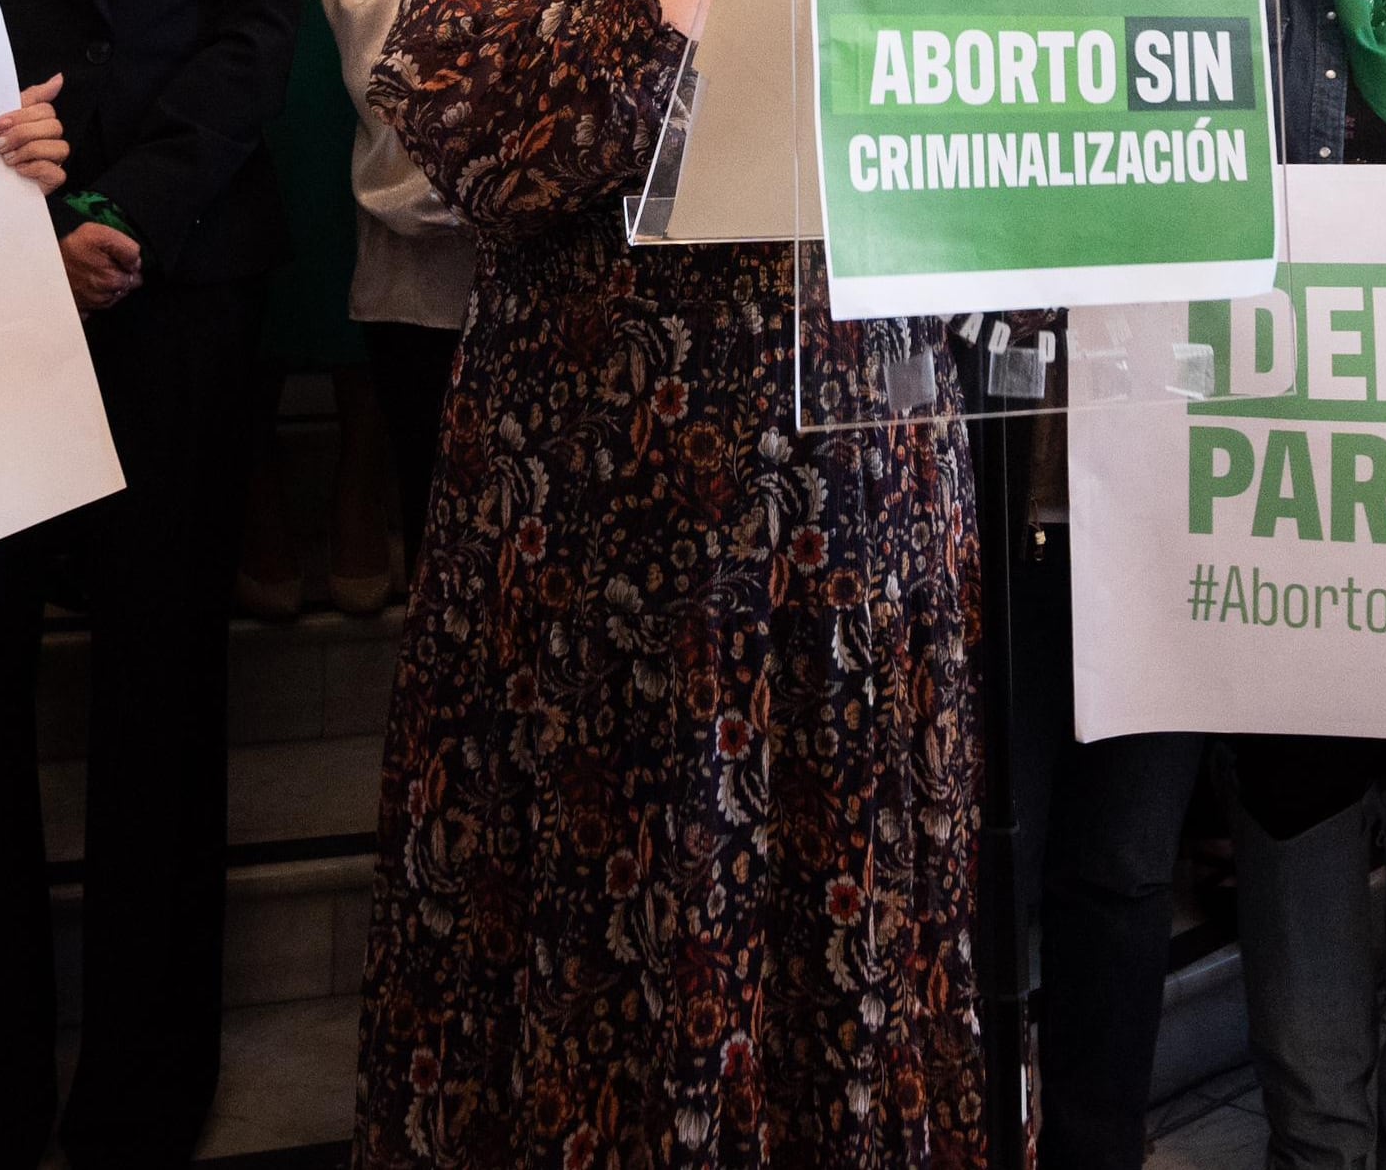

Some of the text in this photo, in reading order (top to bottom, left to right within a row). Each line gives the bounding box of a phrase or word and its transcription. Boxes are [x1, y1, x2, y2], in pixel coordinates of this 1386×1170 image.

[869, 29, 1234, 105] ABORTO SIN
[848, 116, 1248, 192] CRIMINALIZACIÓN
